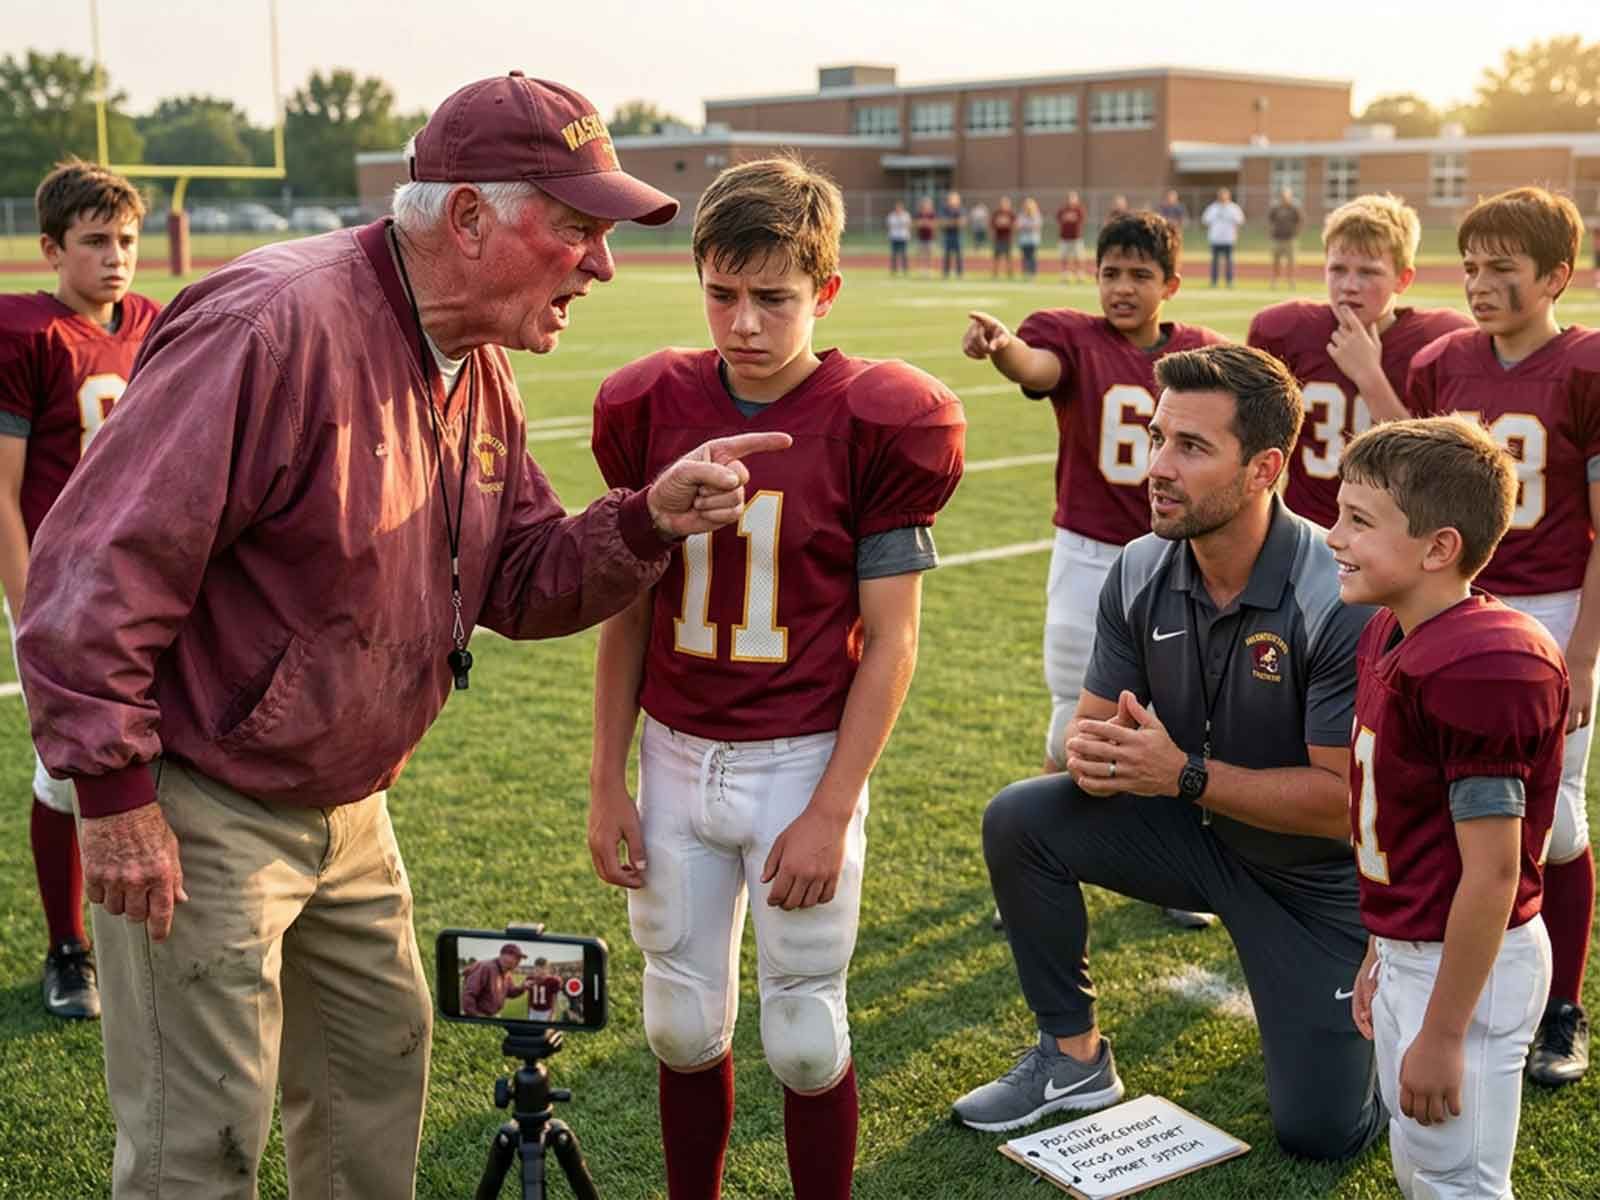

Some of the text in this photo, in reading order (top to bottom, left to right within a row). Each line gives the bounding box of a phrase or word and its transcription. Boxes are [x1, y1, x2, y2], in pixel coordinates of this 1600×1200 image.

[673, 489, 789, 663] 11
[1350, 714, 1391, 886] 1
[1040, 1122, 1102, 1149] POSITIVE
